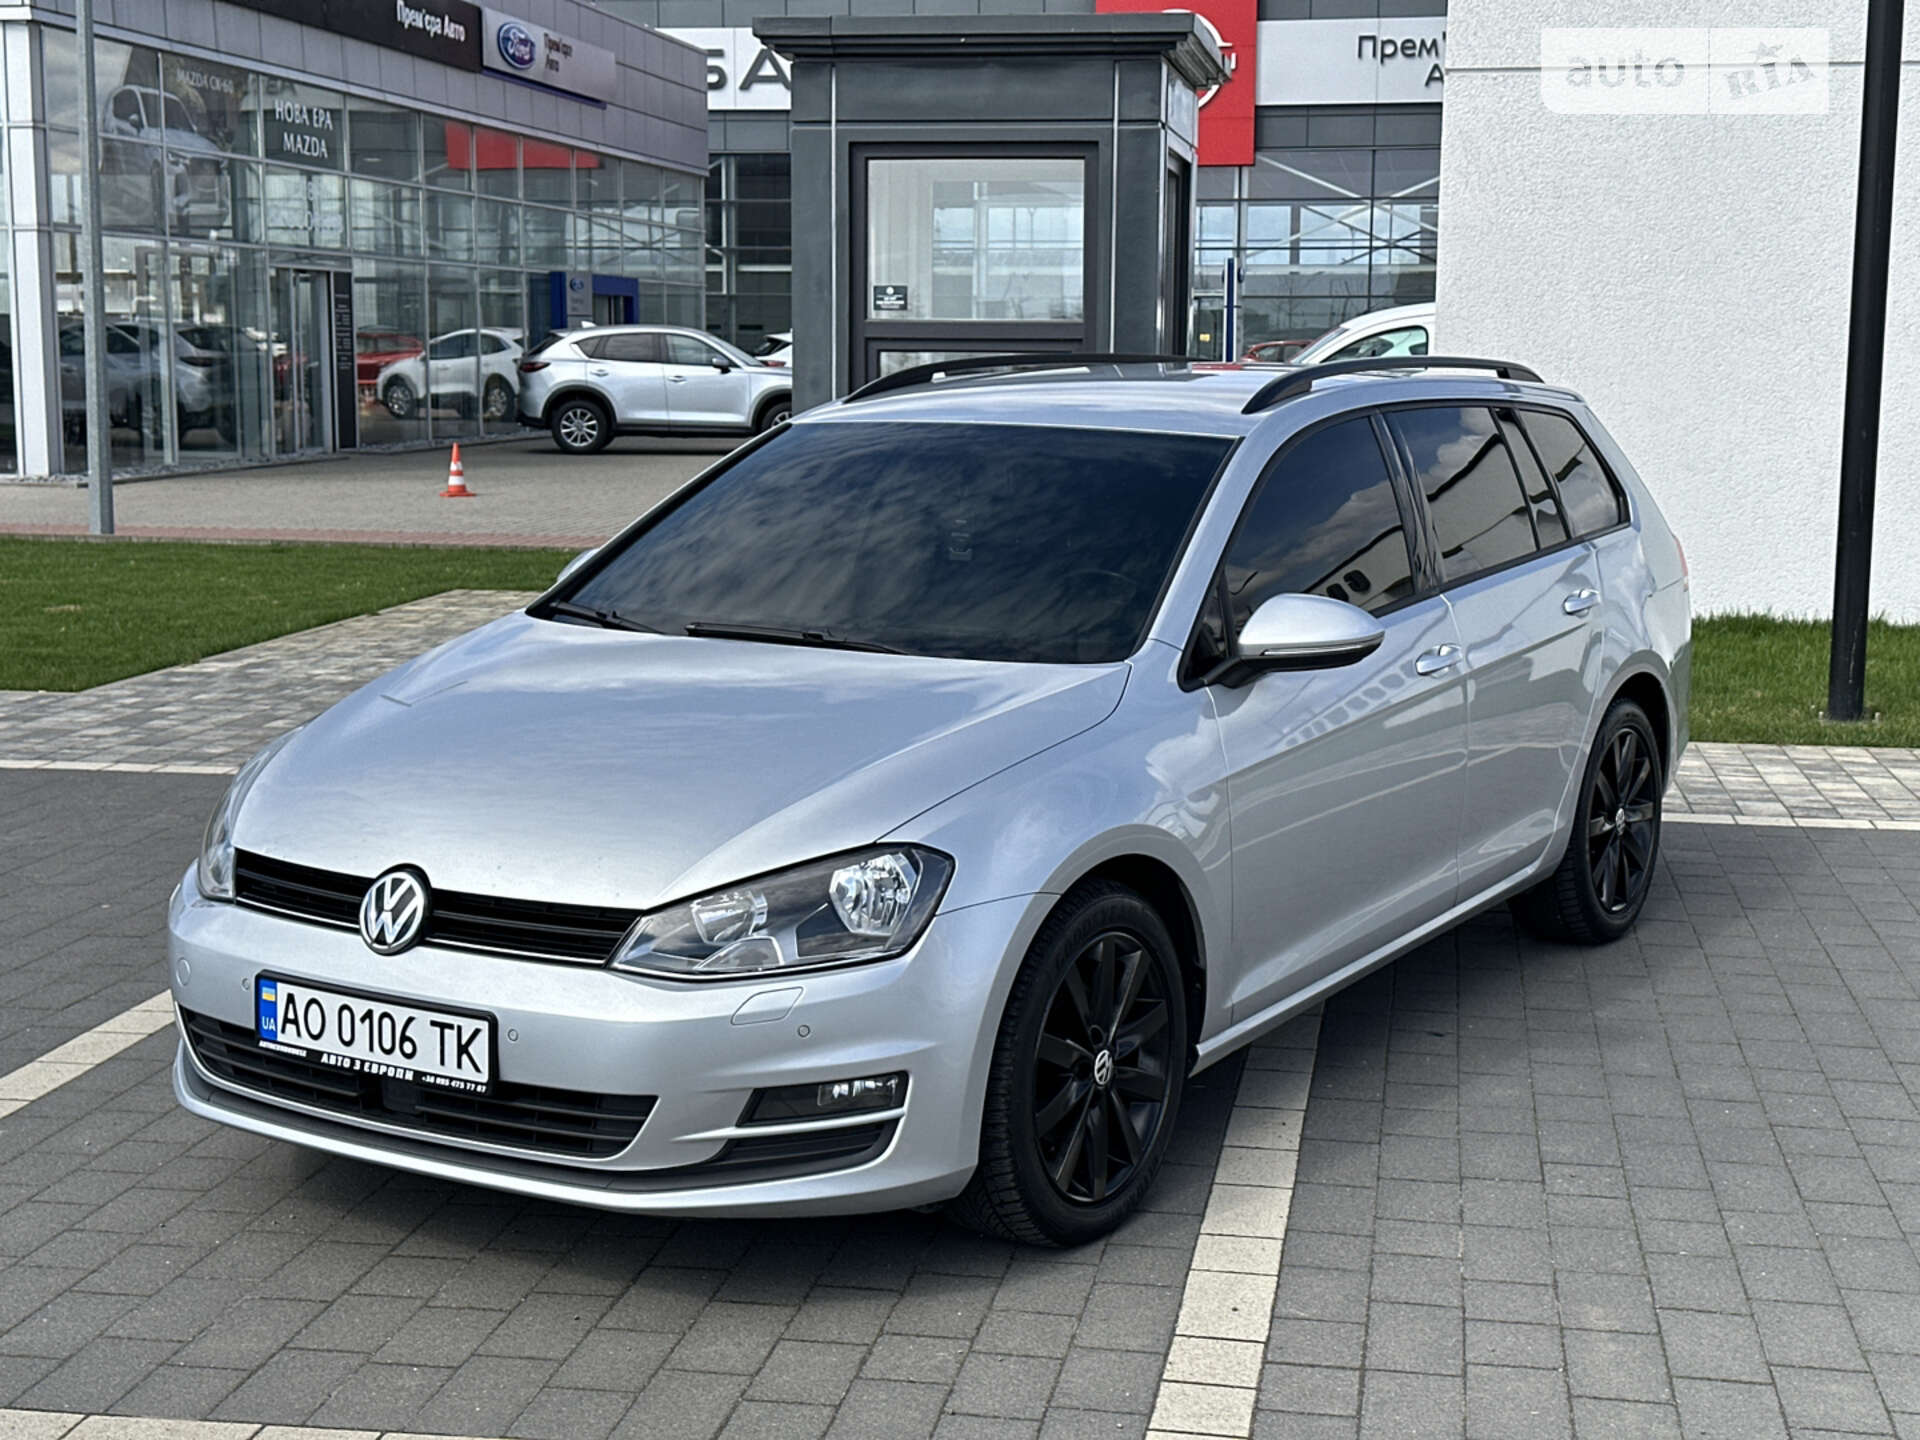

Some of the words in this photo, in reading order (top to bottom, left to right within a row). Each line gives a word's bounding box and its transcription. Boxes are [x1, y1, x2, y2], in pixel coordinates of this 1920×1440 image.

[274, 99, 310, 127] НОВА
[311, 107, 334, 131] ЕРА
[283, 132, 328, 159] MAZDA
[261, 1015, 276, 1032] UA
[280, 992, 326, 1041] AO
[337, 1003, 417, 1060] 0106
[429, 1019, 483, 1075] TK
[320, 1052, 351, 1069] АВТО
